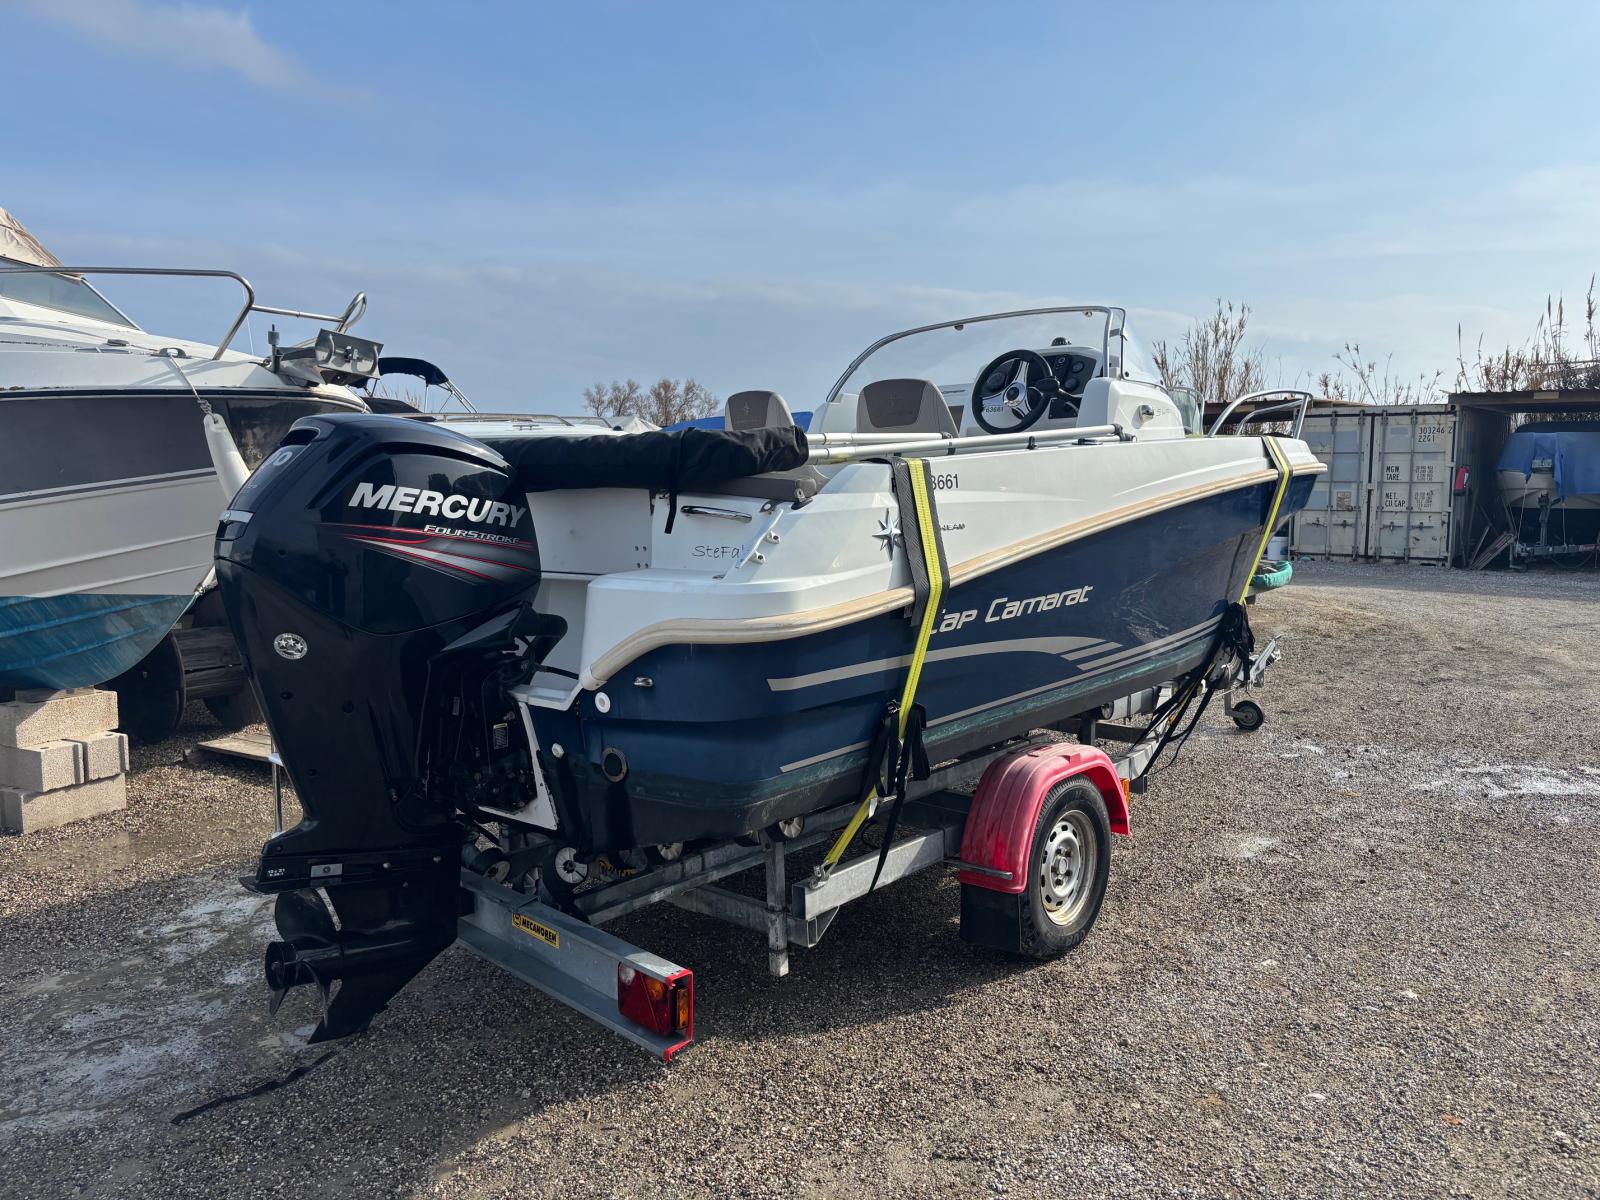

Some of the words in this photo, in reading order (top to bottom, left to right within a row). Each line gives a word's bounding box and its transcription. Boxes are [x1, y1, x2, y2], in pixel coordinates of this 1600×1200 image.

[348, 482, 527, 528] MERCURY
[930, 608, 978, 635] ap
[984, 585, 1093, 623] Camarat
